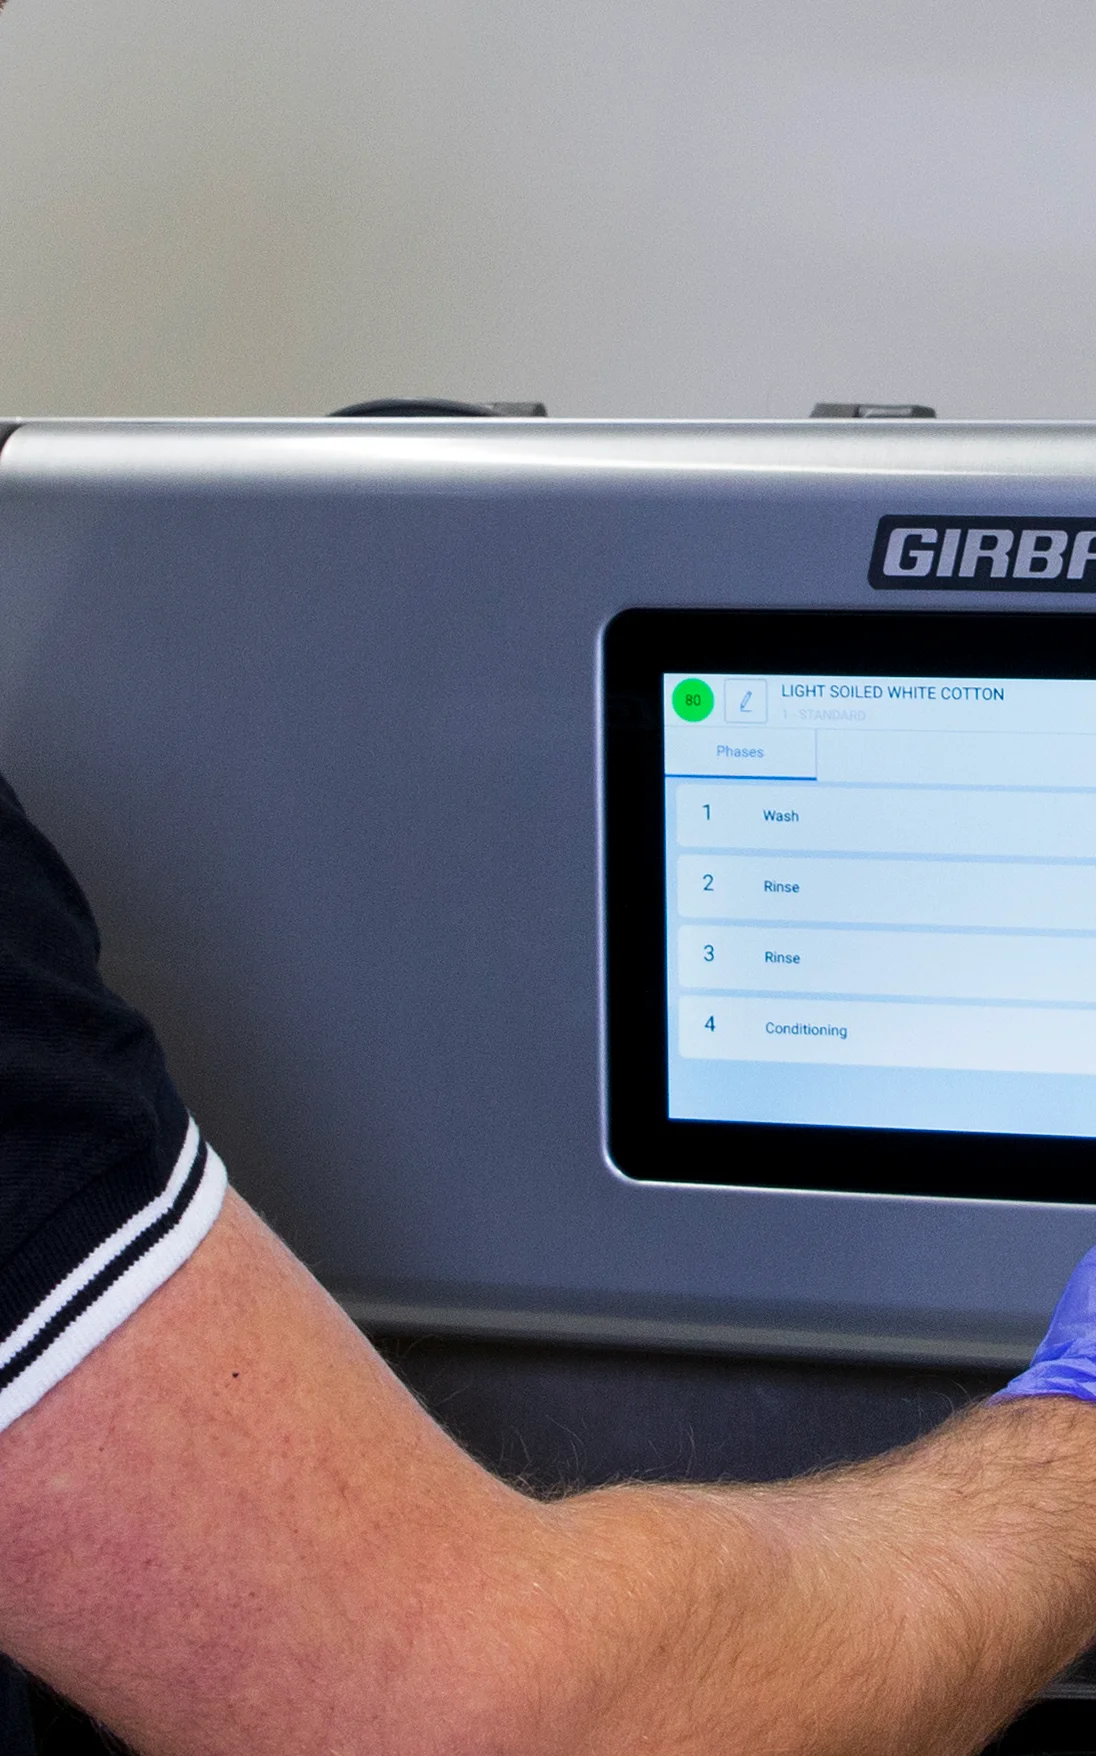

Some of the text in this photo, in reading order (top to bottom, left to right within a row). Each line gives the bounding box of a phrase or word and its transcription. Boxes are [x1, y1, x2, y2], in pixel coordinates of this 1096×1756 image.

[685, 694, 701, 707] 80
[781, 684, 1005, 701] LIGHT SOILED WHITE COTTON
[799, 709, 866, 721] STANDARD
[716, 744, 765, 759] Phases
[702, 805, 799, 822] 1 Wash
[703, 875, 800, 894] 2 Rinse
[703, 945, 801, 964] 3 Rinse
[704, 1016, 848, 1039] 4 Conditioning
